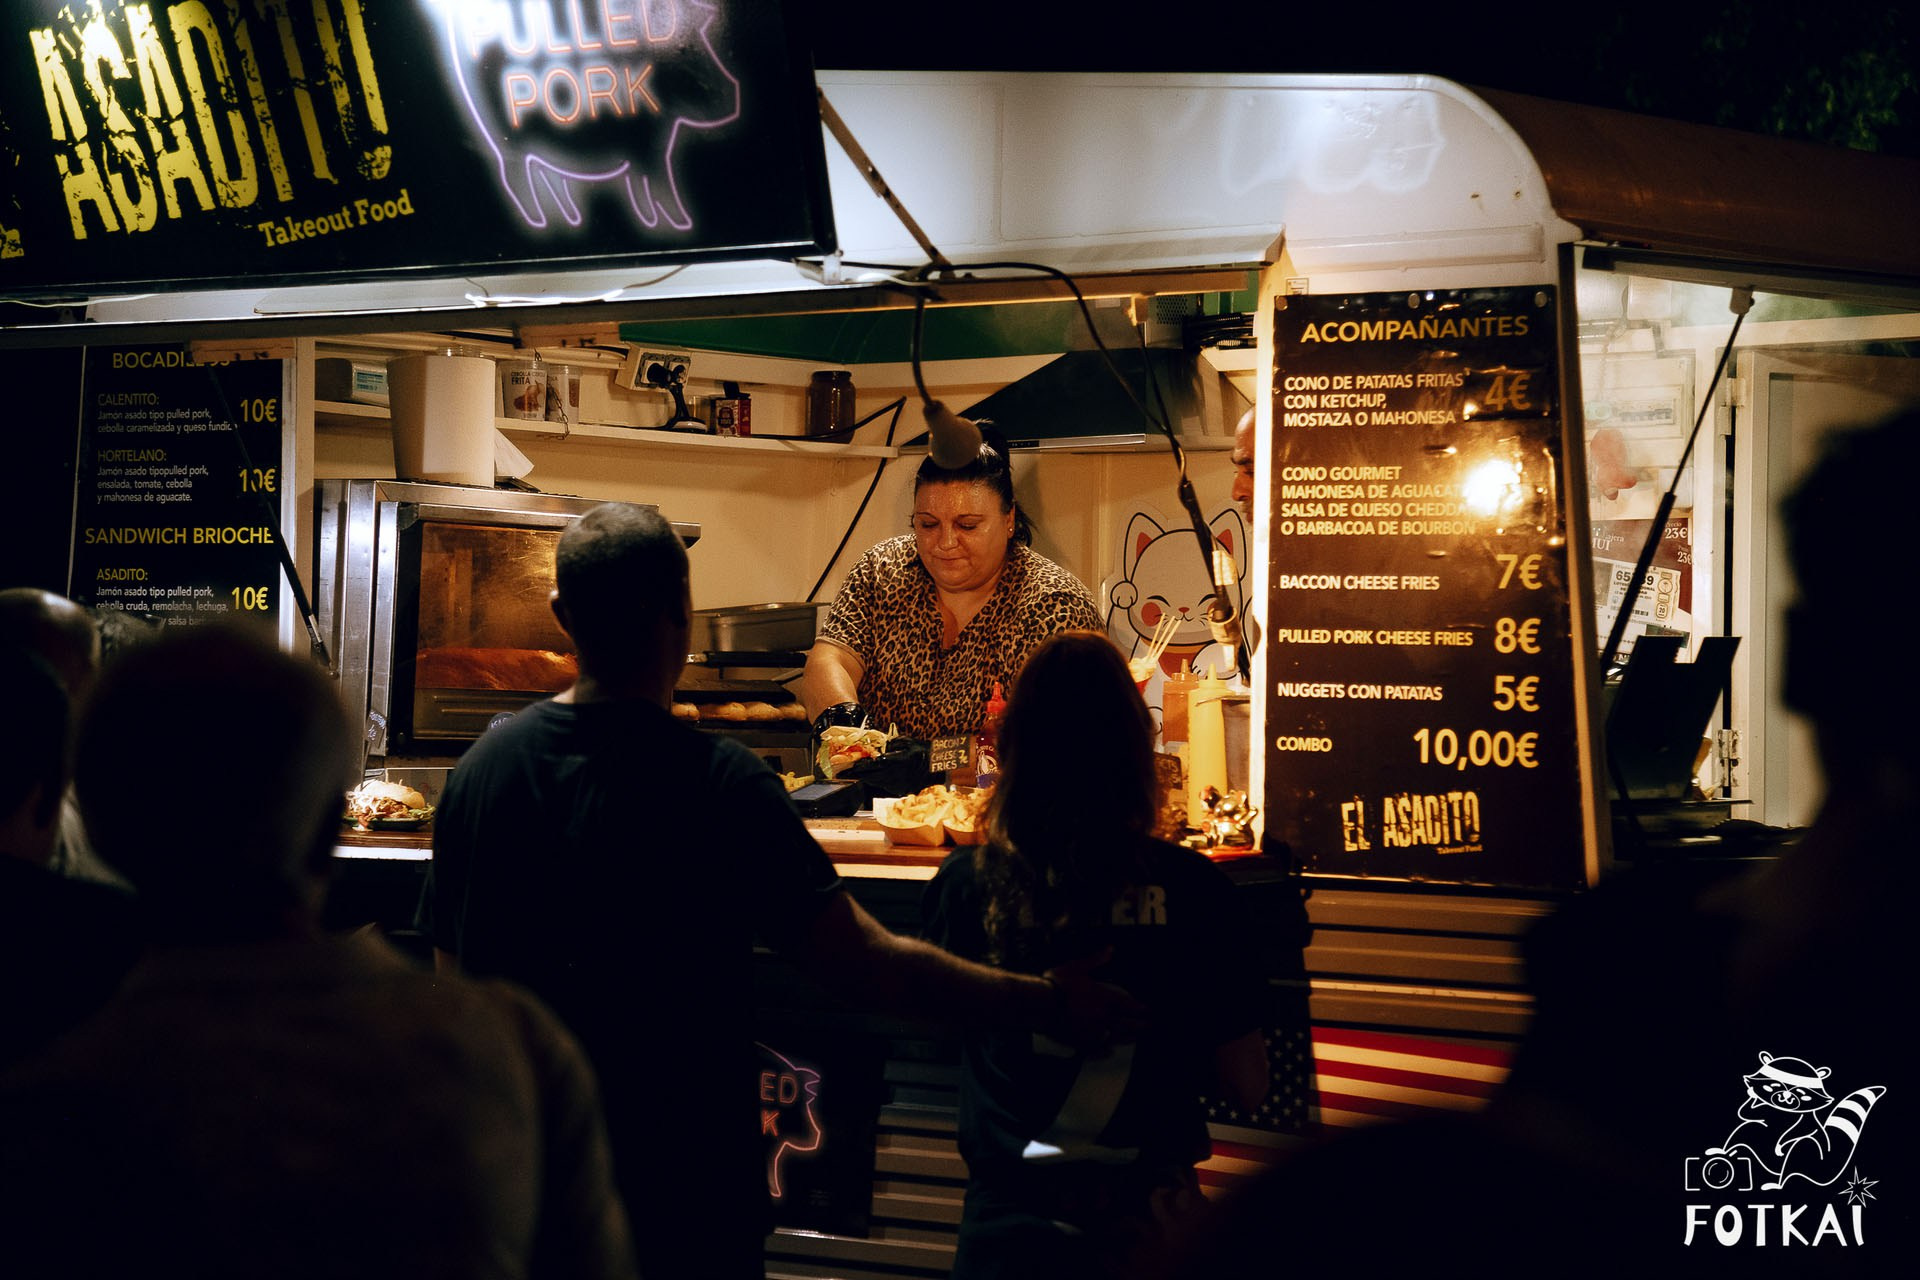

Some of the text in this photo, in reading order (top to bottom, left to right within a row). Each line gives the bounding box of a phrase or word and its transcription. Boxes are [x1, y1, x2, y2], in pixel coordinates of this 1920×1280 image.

[506, 64, 661, 129] PORK
[258, 188, 415, 248] Takeout Food
[1301, 315, 1529, 343] ACOMPAÑANTES
[1284, 373, 1464, 391] CONO DE PATATAS FRITAS
[98, 393, 159, 406] CALENTITO:
[1484, 374, 1532, 411] 4€
[1284, 394, 1387, 409] CON KETCHUP,
[125, 409, 147, 419] asado
[149, 409, 165, 421] tipo
[167, 408, 190, 420] pulled
[192, 408, 212, 420] pork,
[240, 398, 277, 423] 10€
[1284, 410, 1456, 427] MOSTAZA O MAHONESA
[127, 422, 175, 433] caramelizada
[177, 424, 181, 434] y
[183, 423, 206, 434] queso
[97, 449, 167, 461] HORTELANO:
[97, 465, 209, 477] Jamón asado tipopulled pork,
[1282, 466, 1402, 481] CONO GOURMET
[97, 478, 192, 490] ensalada, tomate, cebolla
[239, 468, 276, 492] 10€
[97, 491, 193, 504] y mahonesa de aguacate.
[1282, 485, 1365, 499] MAHONESA
[1368, 485, 1387, 499] DE
[1281, 502, 1470, 518] SALSA DE QUESO CHEDDA
[85, 527, 274, 544] SANDWICH BRIOCHE
[1281, 520, 1476, 536] O BARBACOA DE BOURBON
[1665, 527, 1688, 539] 23€
[96, 568, 148, 581] ASADITO:
[1496, 554, 1543, 590] 7€
[1280, 575, 1440, 591] BACCON CHEESE FRIES
[96, 585, 214, 598] Jamón asado tipo pulled pork,
[231, 586, 269, 611] 10€
[126, 601, 150, 611] cruda,
[152, 600, 194, 611] remolacha,
[196, 601, 228, 614] lechuga,
[168, 615, 187, 626] salsa
[1278, 629, 1474, 646] PULLED PORK CHEESE FRIES
[1494, 617, 1542, 654] 8€
[1277, 683, 1443, 701] NUGGETS CON PATATAS
[1493, 675, 1540, 712] 5€
[1276, 737, 1332, 752] COMBO
[1413, 728, 1539, 771] 10,00€
[931, 760, 957, 773] FRIES
[1341, 791, 1480, 852] EL ASADITO
